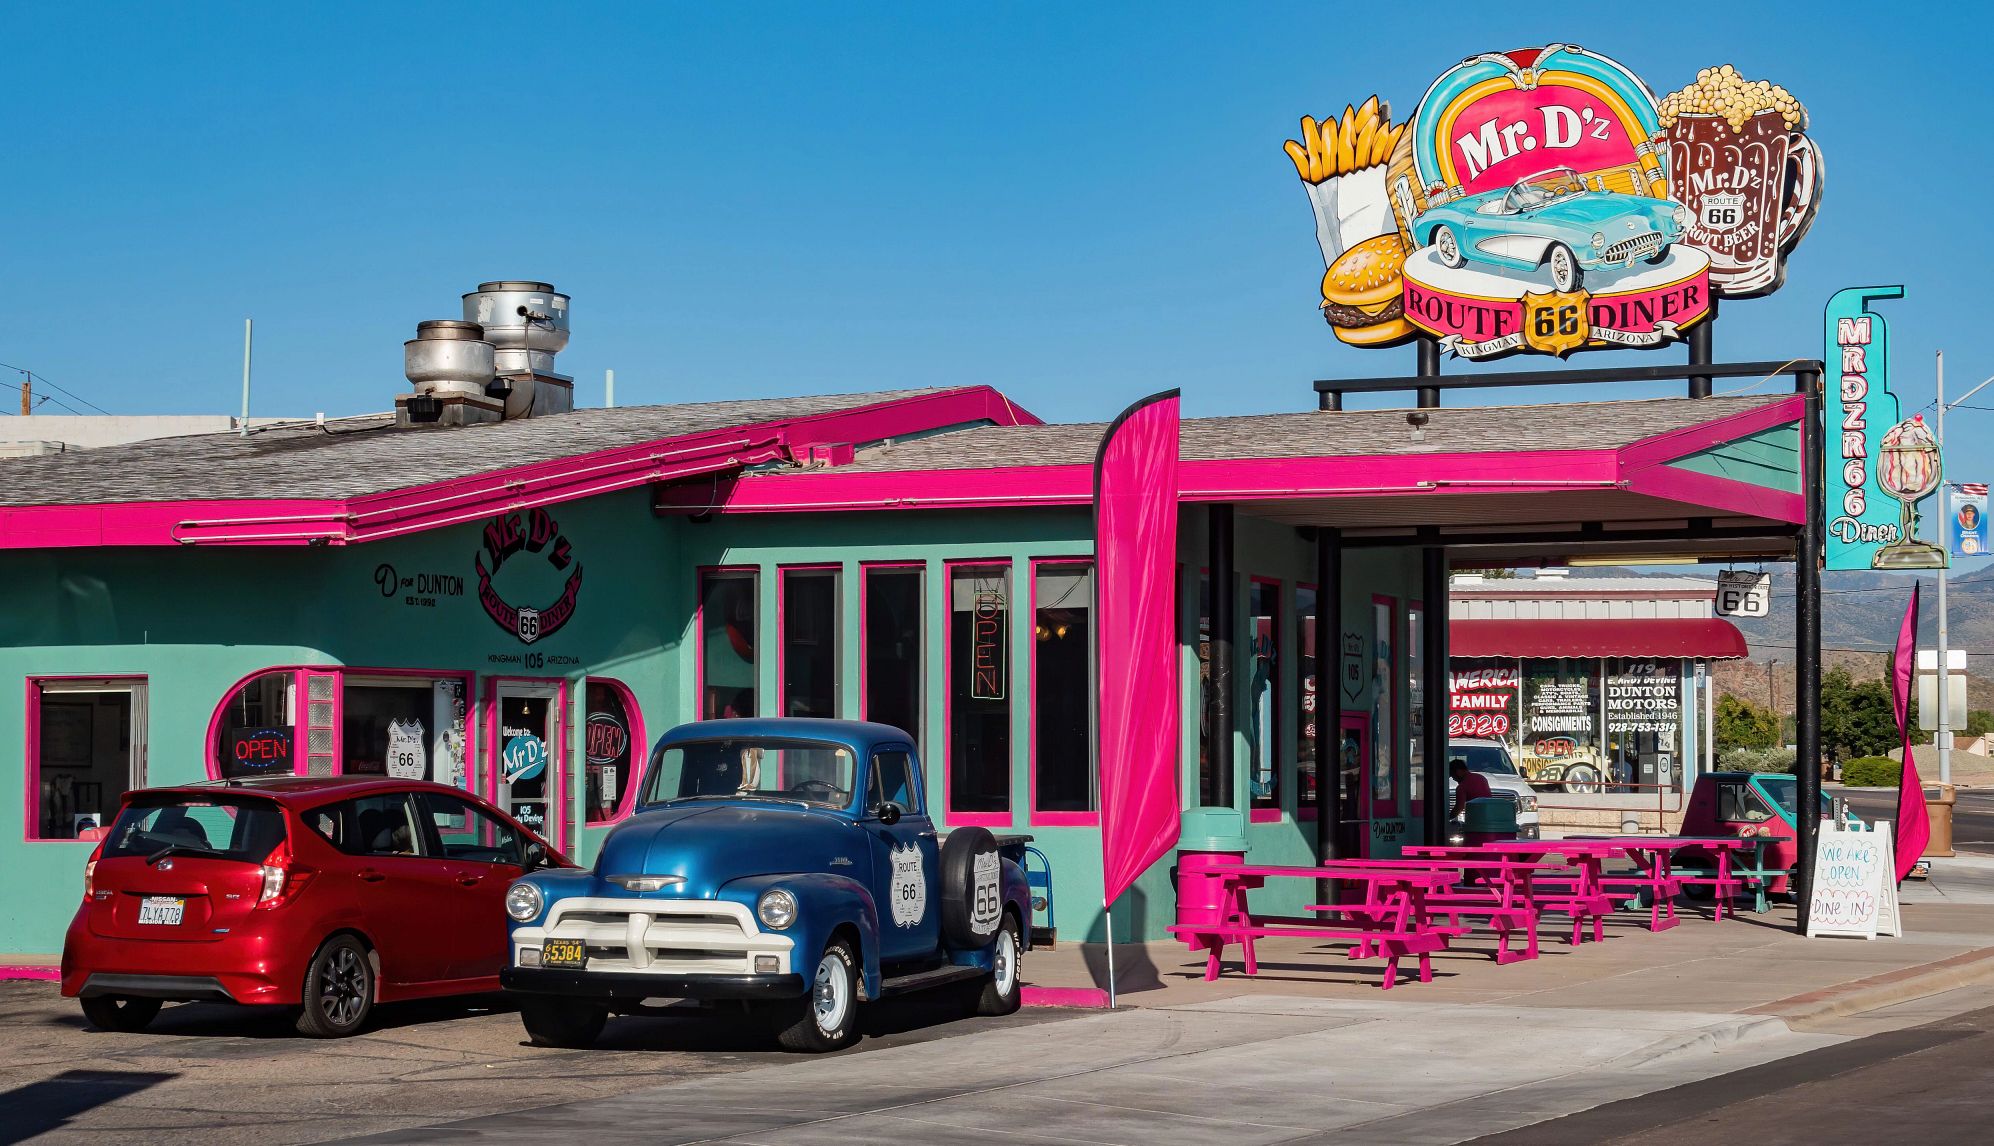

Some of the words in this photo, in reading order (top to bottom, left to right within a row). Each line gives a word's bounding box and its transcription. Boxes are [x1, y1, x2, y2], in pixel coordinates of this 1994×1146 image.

[1707, 197, 1739, 205] ROUTE
[1708, 209, 1736, 224] 66
[1687, 224, 1721, 247] ROOT
[1723, 220, 1760, 247] BEER
[1408, 287, 1513, 337] ROUTE
[1534, 305, 1579, 337] 66
[1592, 284, 1699, 330] DINER
[1460, 335, 1519, 356] KINGMAN
[1593, 328, 1655, 343] ARIZONA
[1830, 516, 1898, 543] Diner
[417, 573, 464, 595] DUNTON
[1723, 590, 1760, 612] 66
[482, 586, 516, 627] ROUTE
[520, 616, 537, 635] 66
[540, 595, 572, 629] DINER
[975, 595, 998, 696] OPEN
[488, 654, 522, 664] KINGMAN
[525, 652, 544, 669] 105
[546, 655, 580, 665] ARIZONA
[1628, 663, 1656, 674] 119
[1608, 686, 1677, 697] DUNTON
[1452, 695, 1509, 708] FAMILY
[1607, 698, 1678, 709] MOTORS
[1531, 715, 1592, 731] CONSIGNMENTS
[1607, 711, 1655, 720] Established
[1657, 711, 1678, 720] 1946
[1449, 714, 1508, 735] 2020
[586, 722, 622, 757] OPEN
[1535, 739, 1575, 756] OPEN
[235, 739, 287, 759] OPEN
[399, 752, 414, 766] 66
[520, 805, 532, 815] 105
[523, 814, 544, 824] Devine
[898, 862, 917, 872] ROUTE
[902, 883, 916, 900] 66
[976, 883, 998, 915] 66
[142, 906, 181, 921] 7LYA778
[1850, 902, 1865, 915] IN
[551, 945, 582, 961] 5384
